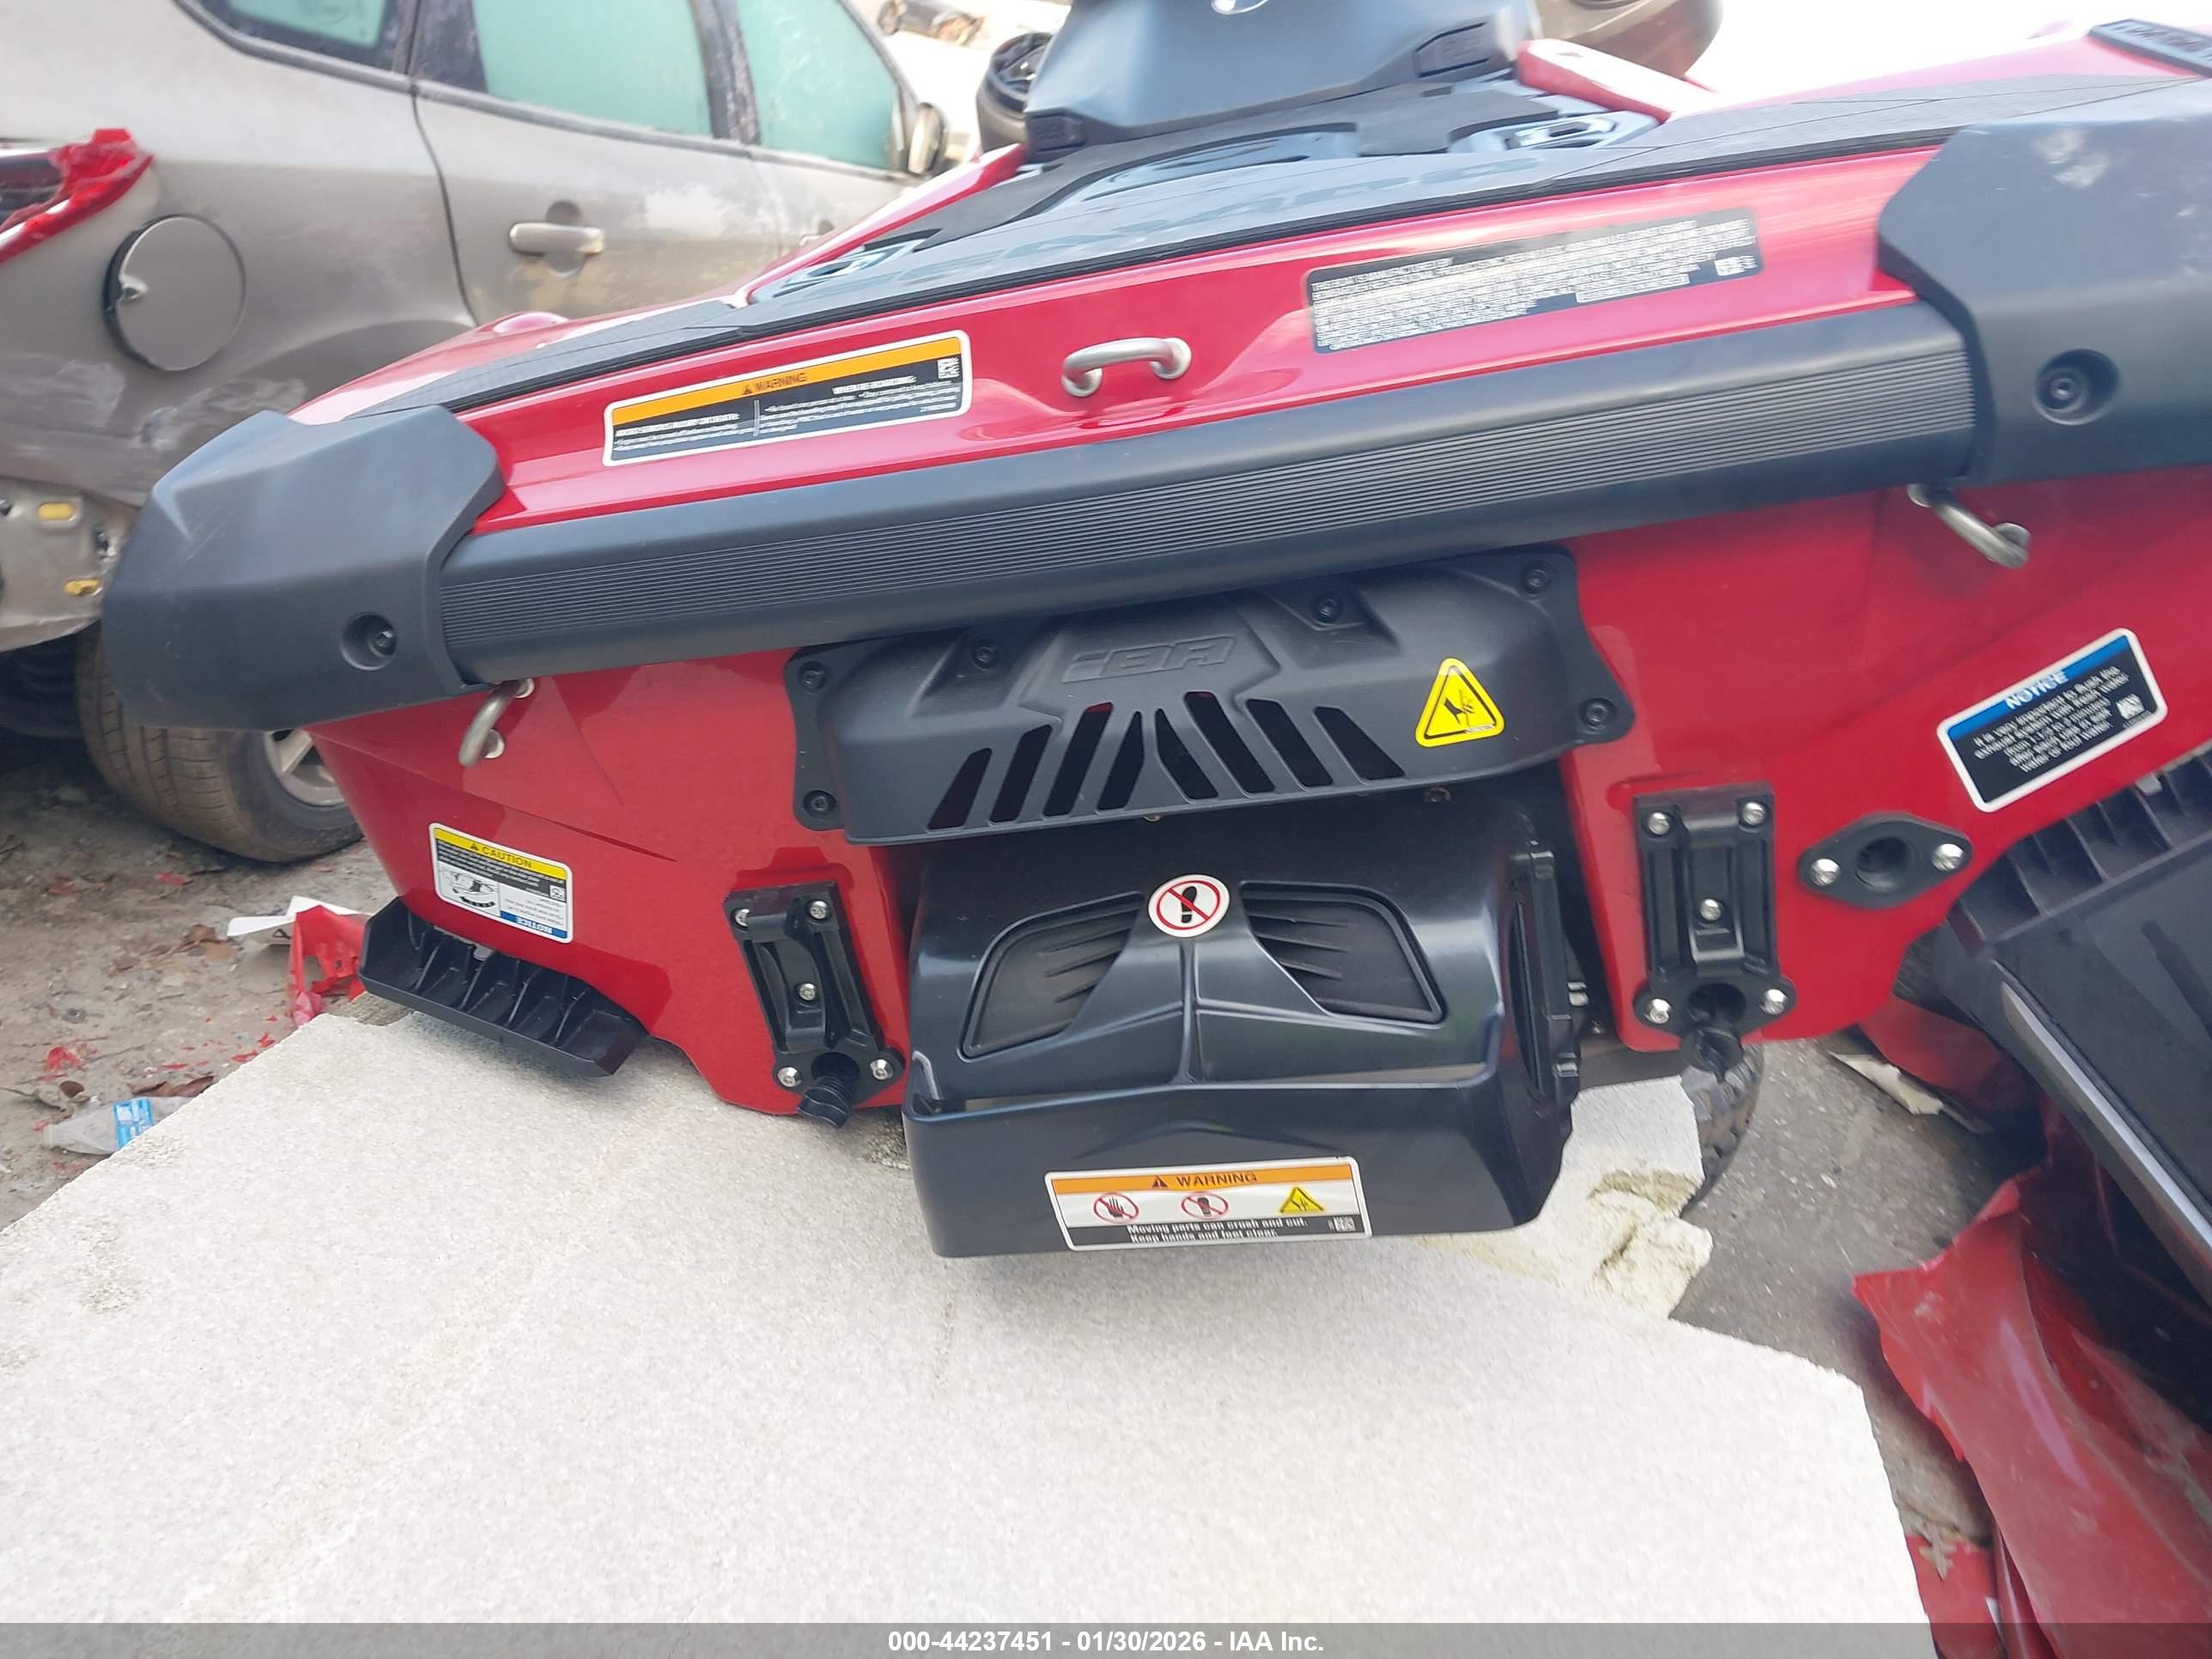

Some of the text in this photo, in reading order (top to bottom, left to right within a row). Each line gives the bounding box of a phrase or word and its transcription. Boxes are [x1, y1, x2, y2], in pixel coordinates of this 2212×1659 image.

[756, 373, 807, 391] WARNING
[2004, 671, 2069, 709] NOTICE
[483, 847, 532, 867] CAUTION
[515, 917, 553, 934] NOTICE
[1176, 1172, 1258, 1188] WARNING
[1127, 1223, 1170, 1235] Moving
[1171, 1222, 1201, 1234] parts
[1226, 1219, 1260, 1230] crush
[1261, 1218, 1284, 1228] and
[1130, 1234, 1160, 1244] Keep
[1161, 1231, 1196, 1243] hands
[1198, 1231, 1219, 1241] and
